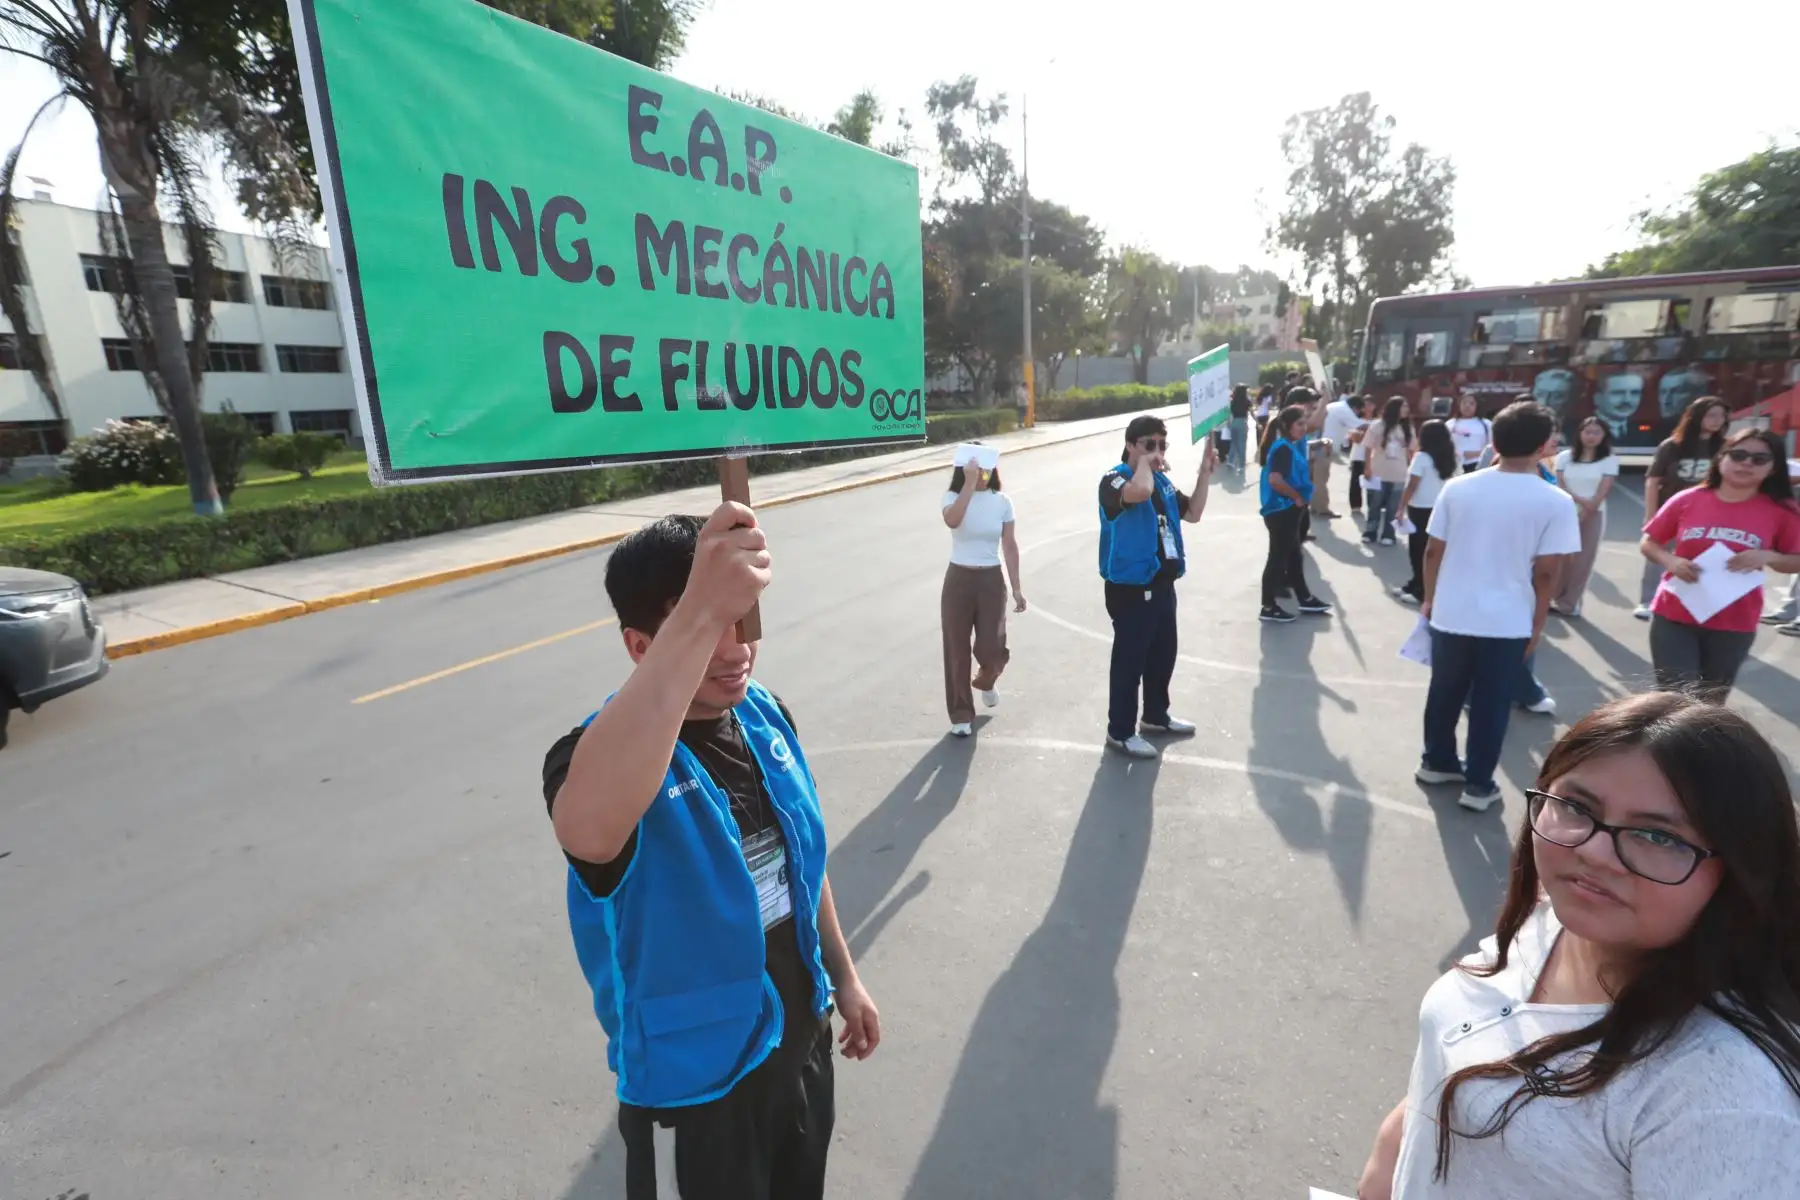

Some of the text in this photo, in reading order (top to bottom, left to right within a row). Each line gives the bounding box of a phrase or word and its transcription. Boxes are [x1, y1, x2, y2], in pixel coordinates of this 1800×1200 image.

[627, 84, 793, 204] E.A.P.
[442, 172, 895, 320] ING. MECÁNICA
[543, 330, 865, 414] DE FLUIDOS
[869, 387, 922, 422] OCA
[1677, 459, 1711, 478] 32
